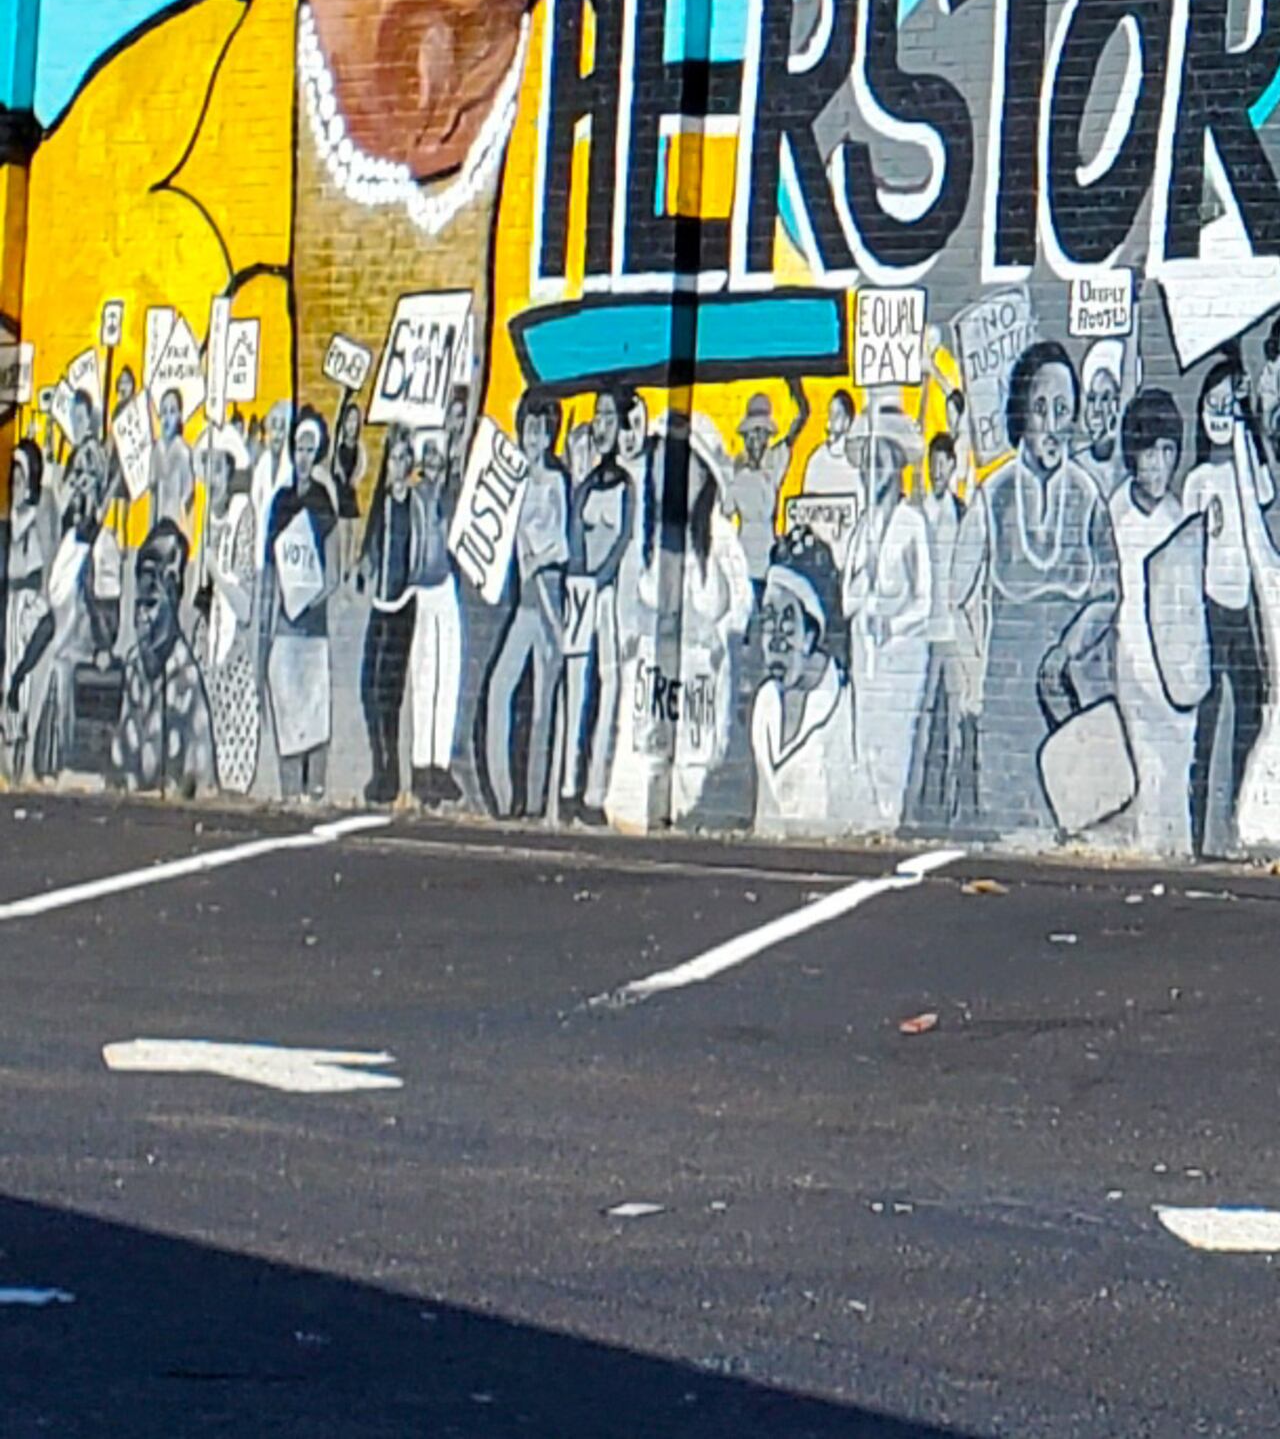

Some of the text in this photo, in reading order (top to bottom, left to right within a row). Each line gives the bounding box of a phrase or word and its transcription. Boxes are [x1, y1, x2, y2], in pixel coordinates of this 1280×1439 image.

[1079, 279, 1127, 304] DEEPLY
[859, 296, 920, 338] EQUAL
[982, 302, 1016, 335] NO
[861, 342, 914, 381] PAY
